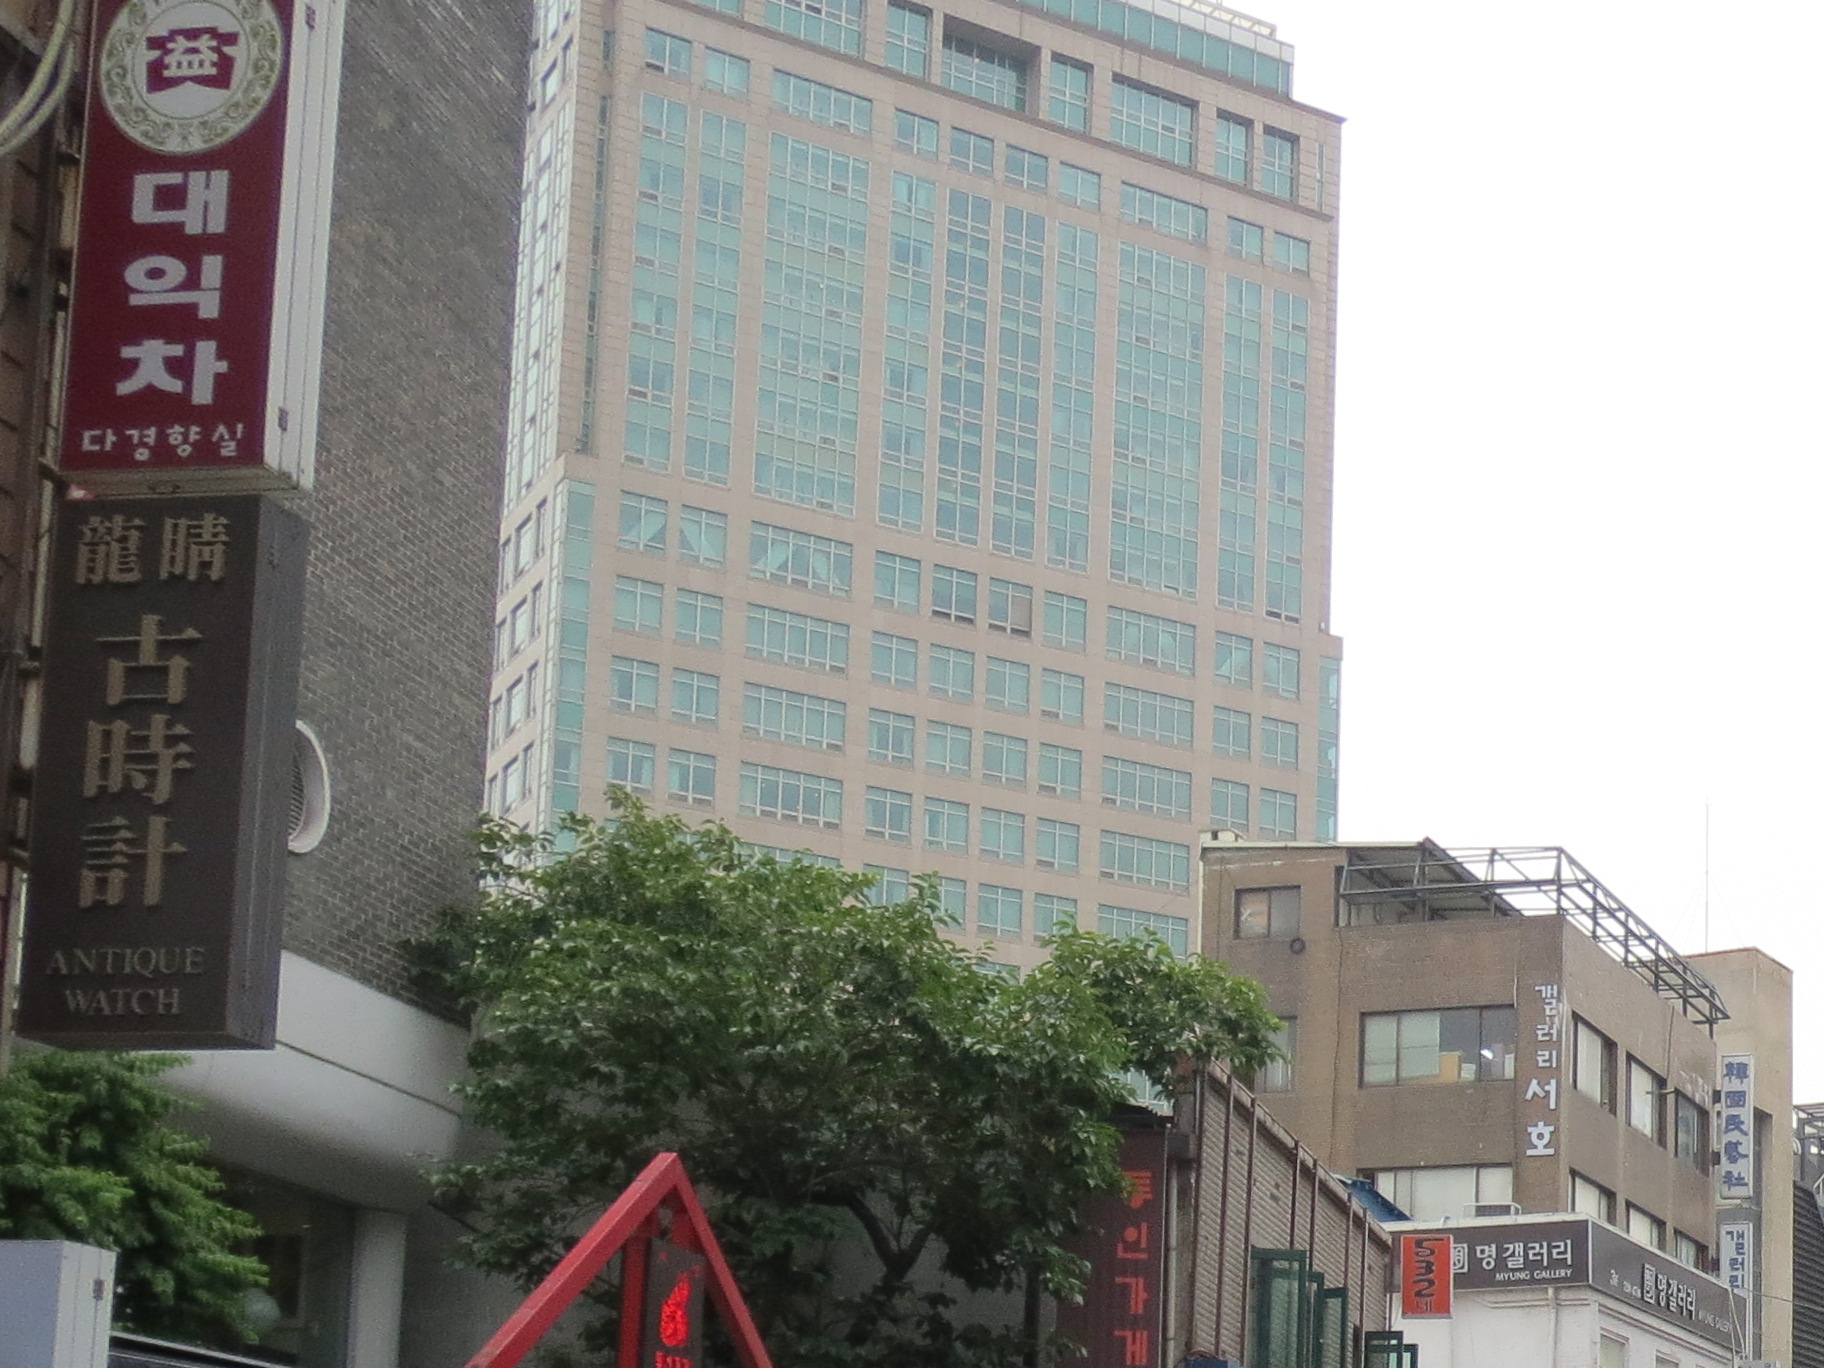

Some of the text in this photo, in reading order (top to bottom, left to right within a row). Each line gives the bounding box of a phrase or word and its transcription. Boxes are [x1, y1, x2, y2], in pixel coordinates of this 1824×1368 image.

[115, 169, 230, 405] 대익차
[82, 423, 243, 461] 다경향실
[78, 614, 203, 907] 古時計
[45, 947, 206, 977] ANTIQUE
[65, 987, 181, 1017] WATCH
[1525, 985, 1558, 1157] 갤러리 서호
[1494, 1268, 1573, 1281] MYUNG GALLERY
